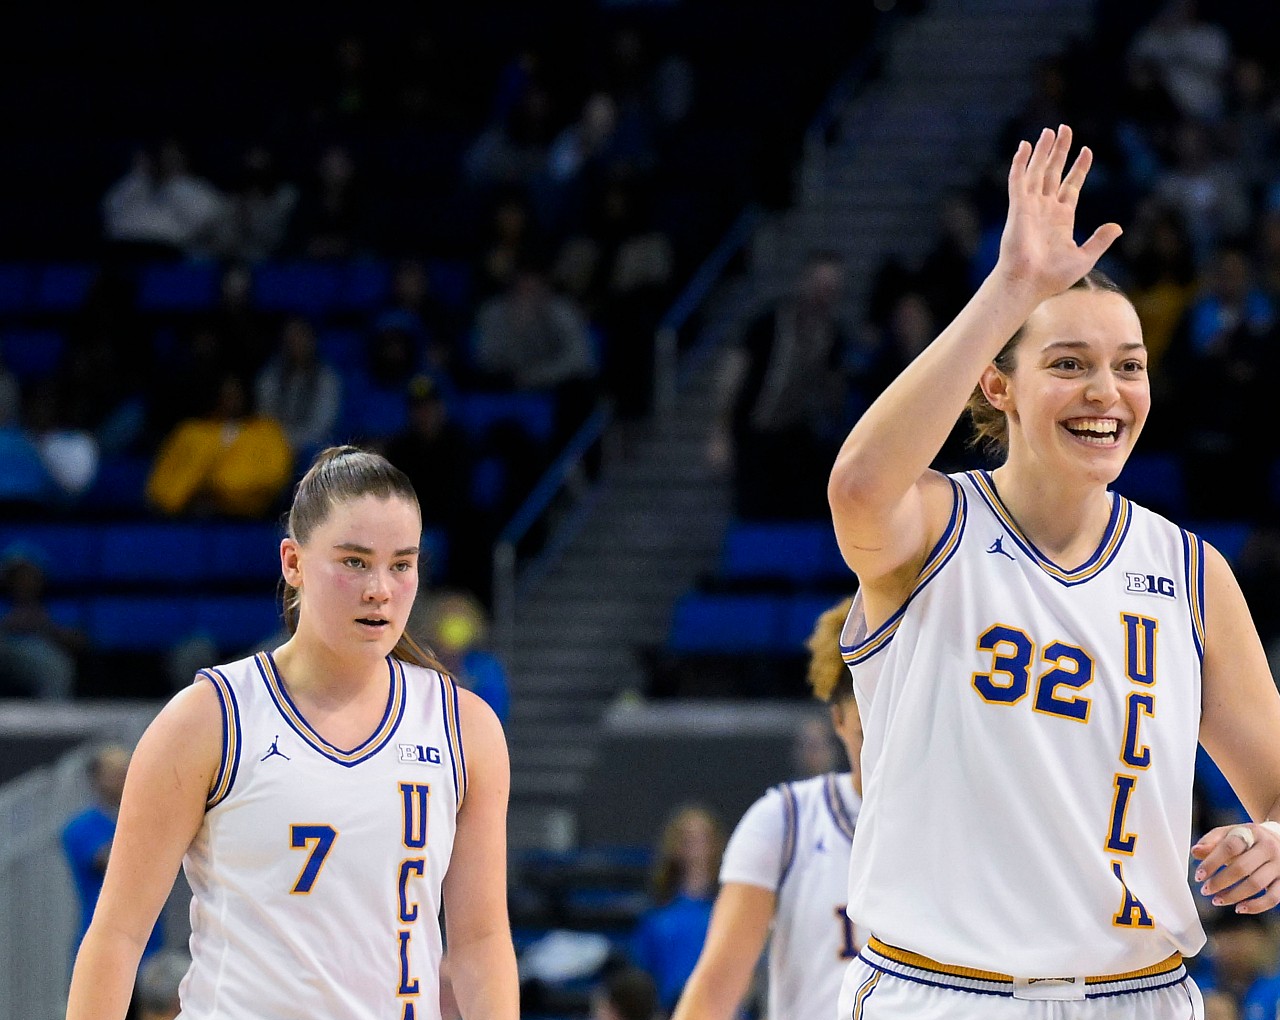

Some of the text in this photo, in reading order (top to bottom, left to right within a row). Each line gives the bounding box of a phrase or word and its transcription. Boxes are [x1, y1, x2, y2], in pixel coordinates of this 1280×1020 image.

[970, 622, 1096, 724] 32
[1103, 611, 1159, 930] UCLA
[289, 823, 340, 895] 7
